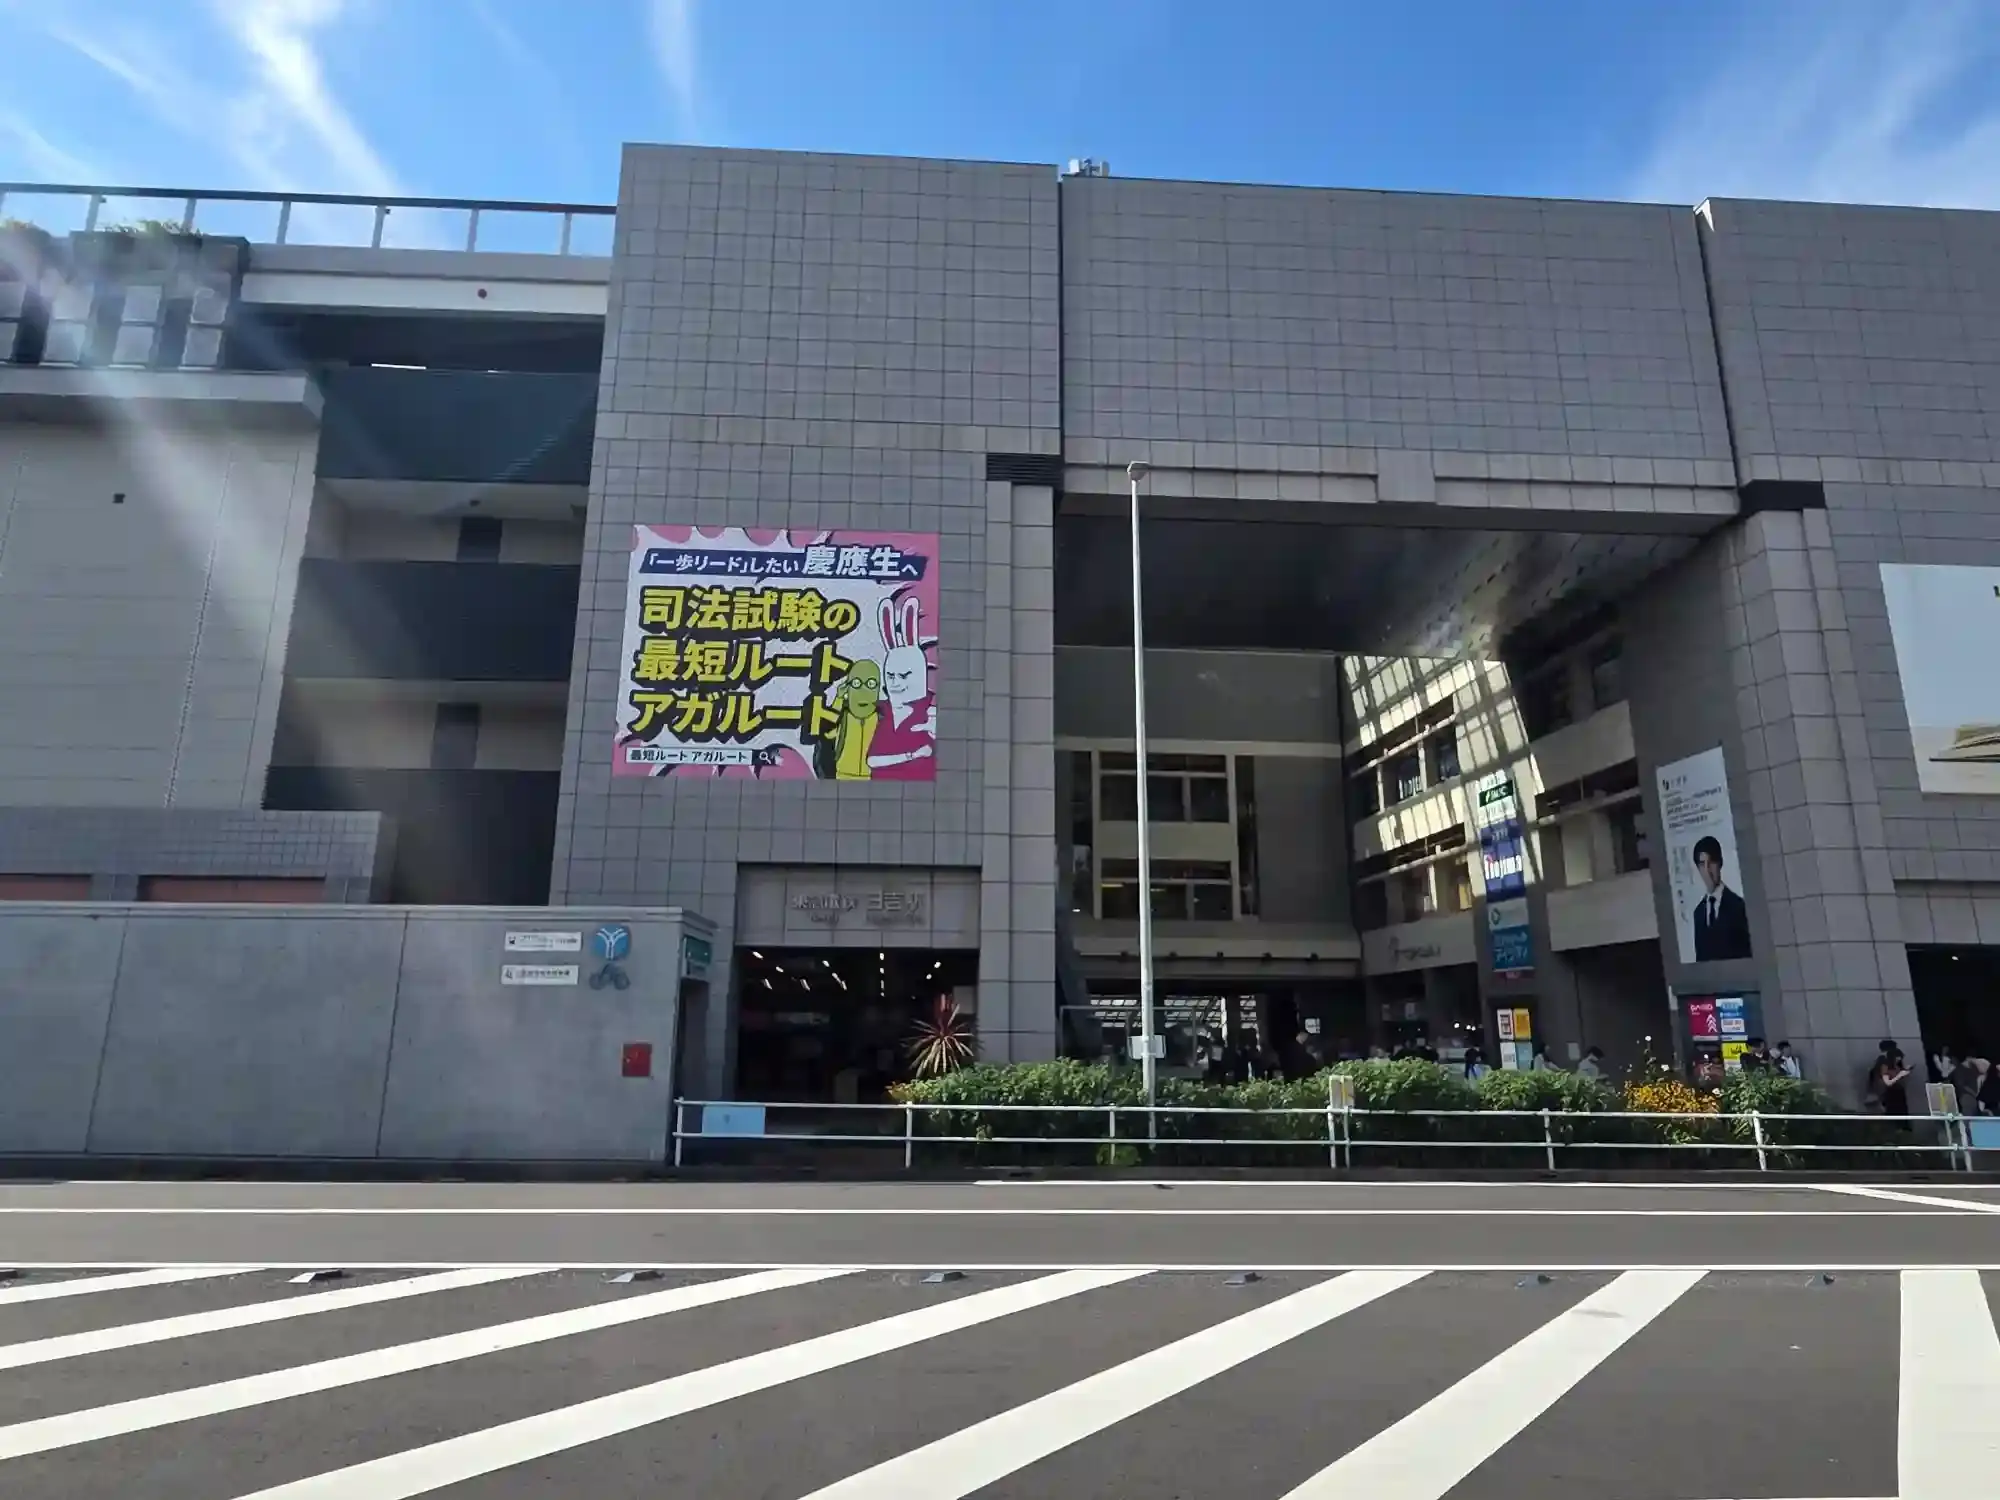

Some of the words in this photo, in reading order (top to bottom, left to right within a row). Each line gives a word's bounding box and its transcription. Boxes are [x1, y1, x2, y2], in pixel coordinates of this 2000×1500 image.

[648, 544, 919, 577] 「一歩リード」したい慶應生へ
[642, 587, 857, 632] 司法試験の
[637, 639, 849, 684] 最短ルート
[631, 692, 842, 738] アガルート
[629, 750, 689, 763] 最短ルート
[691, 751, 748, 763] アガルート
